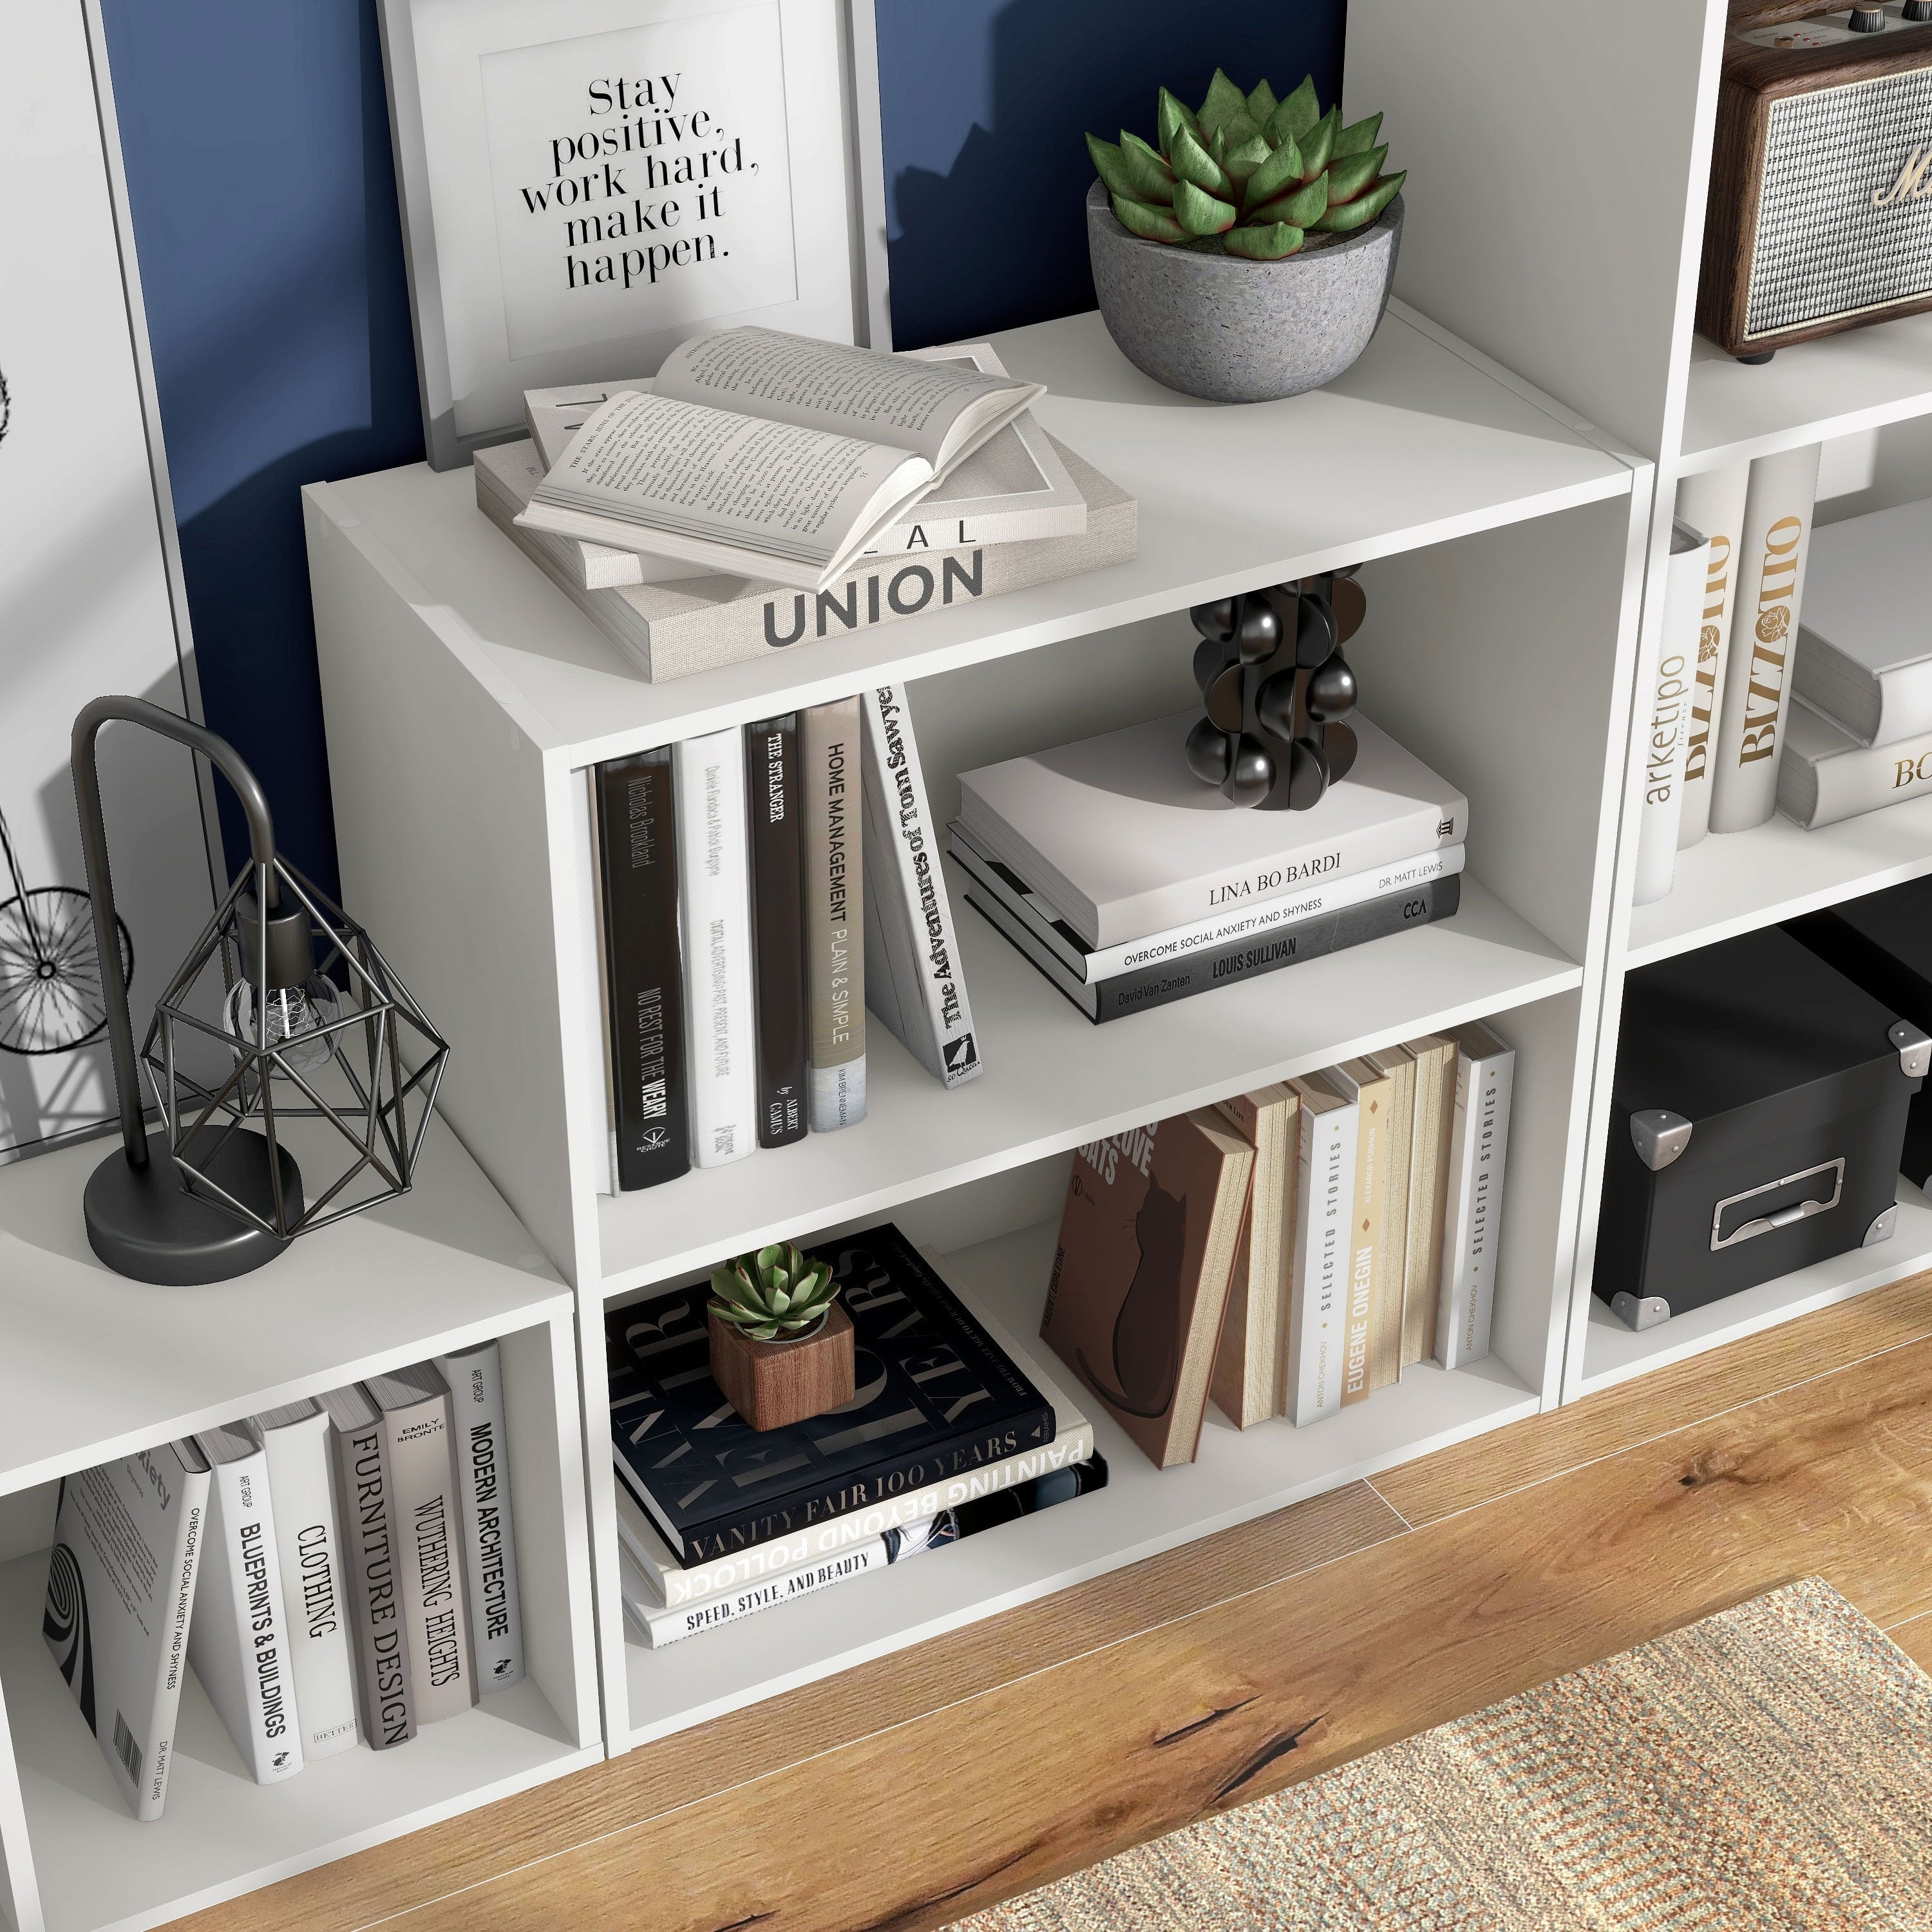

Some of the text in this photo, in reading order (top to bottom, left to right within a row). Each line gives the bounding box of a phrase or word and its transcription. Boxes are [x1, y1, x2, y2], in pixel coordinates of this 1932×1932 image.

[589, 71, 682, 116] Stay
[549, 108, 724, 178] positive,
[519, 138, 759, 213] work hard,
[564, 184, 726, 247] make it
[564, 234, 730, 289] happen.
[569, 456, 582, 468] THE
[580, 435, 598, 453] STARS,
[596, 420, 609, 431] SUNS
[695, 484, 706, 498] starry
[705, 470, 715, 482] vault.
[764, 454, 816, 522] which they have deserted forever.
[816, 511, 828, 527] regular
[842, 466, 862, 486] irregularly.
[764, 549, 983, 647] UNION
[1646, 655, 1689, 805] arketipo
[768, 733, 784, 823] THE STRANGER
[895, 767, 917, 828] Tom
[902, 827, 923, 853] of
[828, 743, 849, 1045] HOME MANAGEMENT PLAIN & SIMPLE
[1209, 853, 1341, 906] LINA BO BARDI
[1379, 862, 1443, 889] DR. MATT LEWIS
[710, 919, 724, 946] DIGITAL
[913, 852, 952, 979] Adventures
[1124, 898, 1322, 966] OVERCOME SOCIAL ANXIETY AND SHYNESS
[1212, 936, 1296, 980] LOUIS SULLIVAN
[941, 982, 961, 1030] The
[1118, 974, 1190, 1006] David Van Zanten
[638, 987, 667, 1119] NO REST FOR THE WEARY
[714, 1037, 728, 1051] AND
[715, 1050, 730, 1077] FUTURE
[770, 1103, 782, 1135] CAMUS
[777, 1086, 792, 1095] by
[786, 1099, 798, 1131] ALBERT
[838, 1082, 847, 1126] BRENNEMAN
[636, 1138, 670, 1151] RESERVE
[641, 1144, 666, 1153] CHUTE
[1364, 1127, 1377, 1204] ALEXANDR PUSHKIN
[1472, 1087, 1497, 1255] SELECTED STORIES
[1320, 1140, 1341, 1311] SELECTED STORIES
[1347, 1246, 1373, 1394] EUGENE ONEGIN
[1465, 1284, 1479, 1351] ANTON CHEKHOV
[471, 1368, 485, 1404] ART GROUP
[1316, 1341, 1328, 1408] ANTON CHEKHOV
[397, 1423, 445, 1444] BRONTE
[402, 1417, 439, 1435] EMILY
[239, 1475, 252, 1508] ART GROUP
[674, 1439, 1083, 1603] PAINTING BEYOND POLLOCK
[690, 1507, 796, 1561] VANITY
[805, 1484, 869, 1525] FAIR
[931, 1430, 1018, 1477] YEARS
[469, 1422, 509, 1641] MODERN ARCHITECTURE
[166, 1508, 200, 1690] OVERCOME SOCIAL ANXIETY AND SHYNESS
[297, 1525, 337, 1638] CLOTHING
[352, 1432, 409, 1745] FURNITURE DESIGN
[415, 1495, 460, 1687] WUTHERING HEIGHTS
[739, 1584, 783, 1612] STYLE,
[788, 1573, 814, 1595] AND
[818, 1552, 869, 1584] BEAUTY
[240, 1522, 287, 1739] BLUEPRINTS & BUILDINGS
[316, 1722, 354, 1740] BETTER
[152, 1741, 168, 1801] DR. MATT LEWIS
